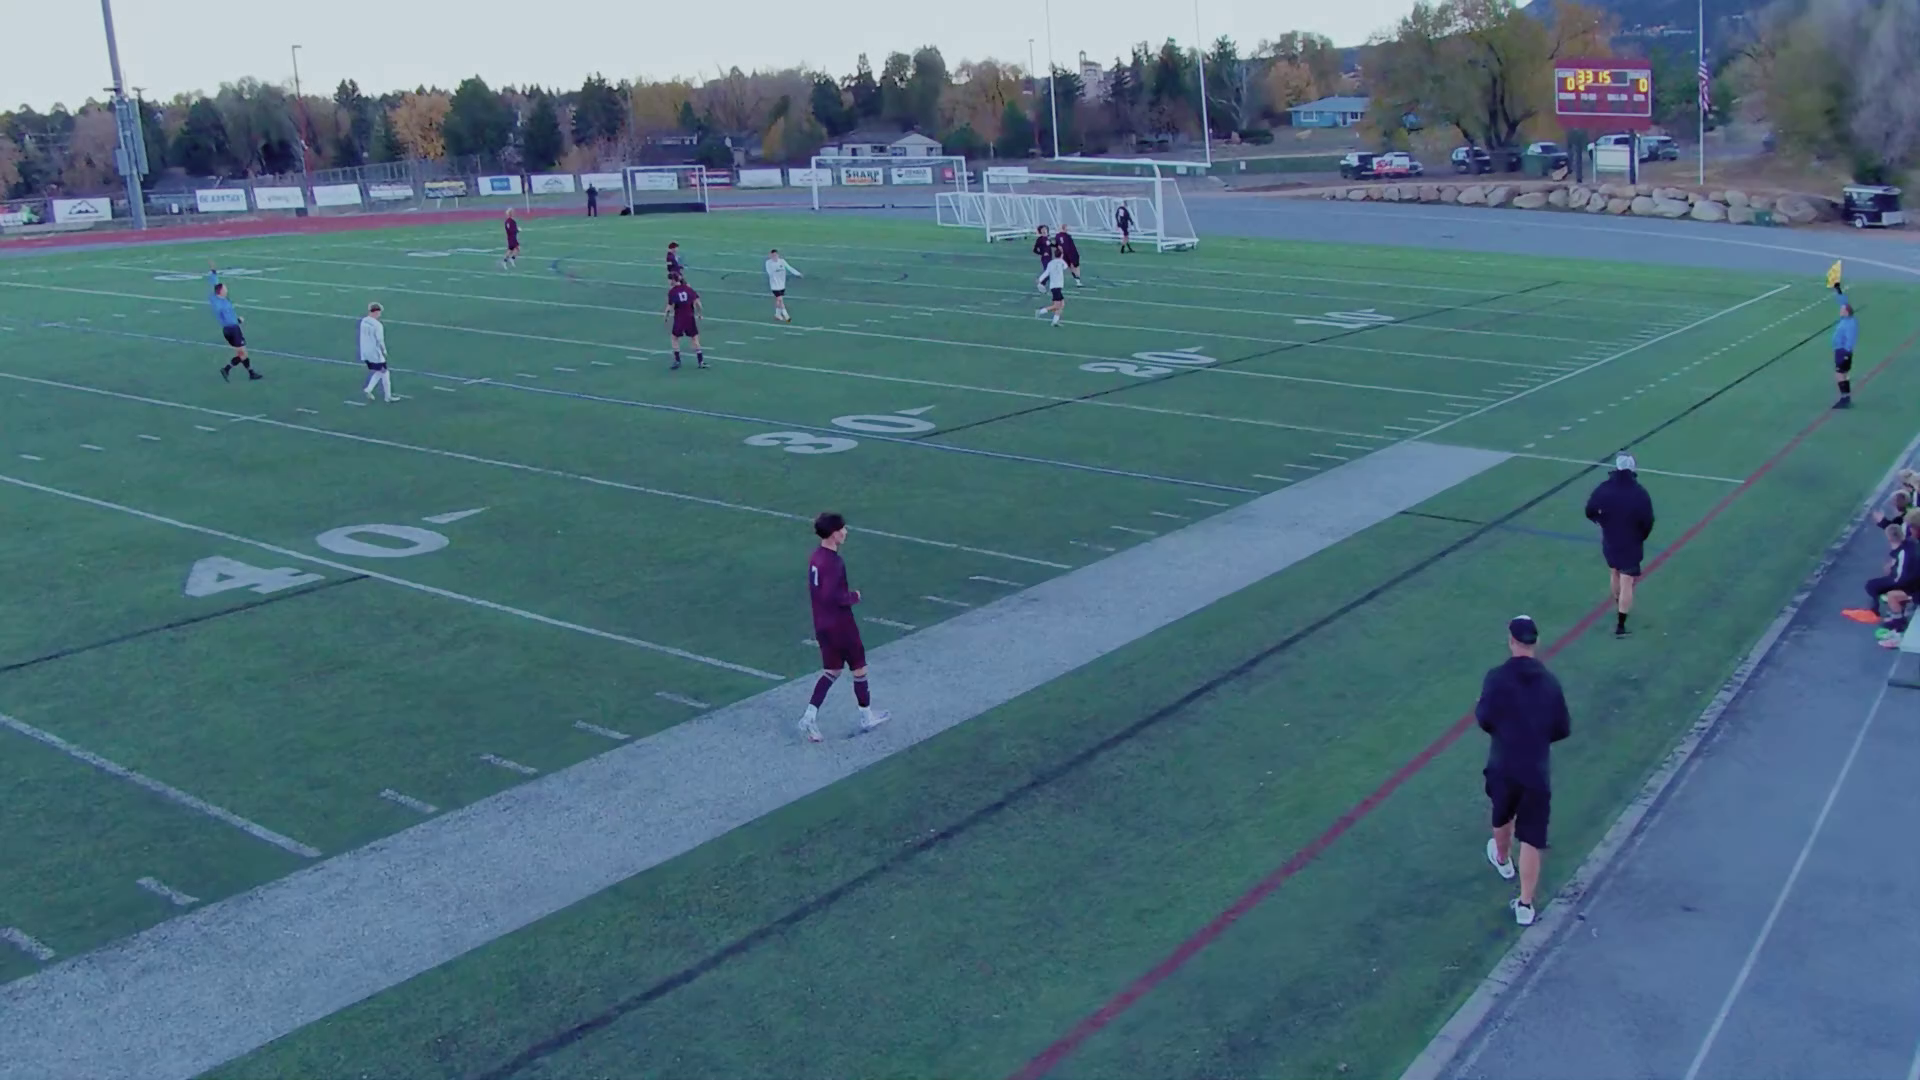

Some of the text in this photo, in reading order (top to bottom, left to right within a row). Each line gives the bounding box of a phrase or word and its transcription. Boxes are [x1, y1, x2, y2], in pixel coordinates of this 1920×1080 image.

[1566, 77, 1575, 91] 0
[1639, 78, 1648, 92] 0
[1079, 351, 1217, 377] 20
[744, 414, 936, 454] 30
[184, 523, 449, 597] 40
